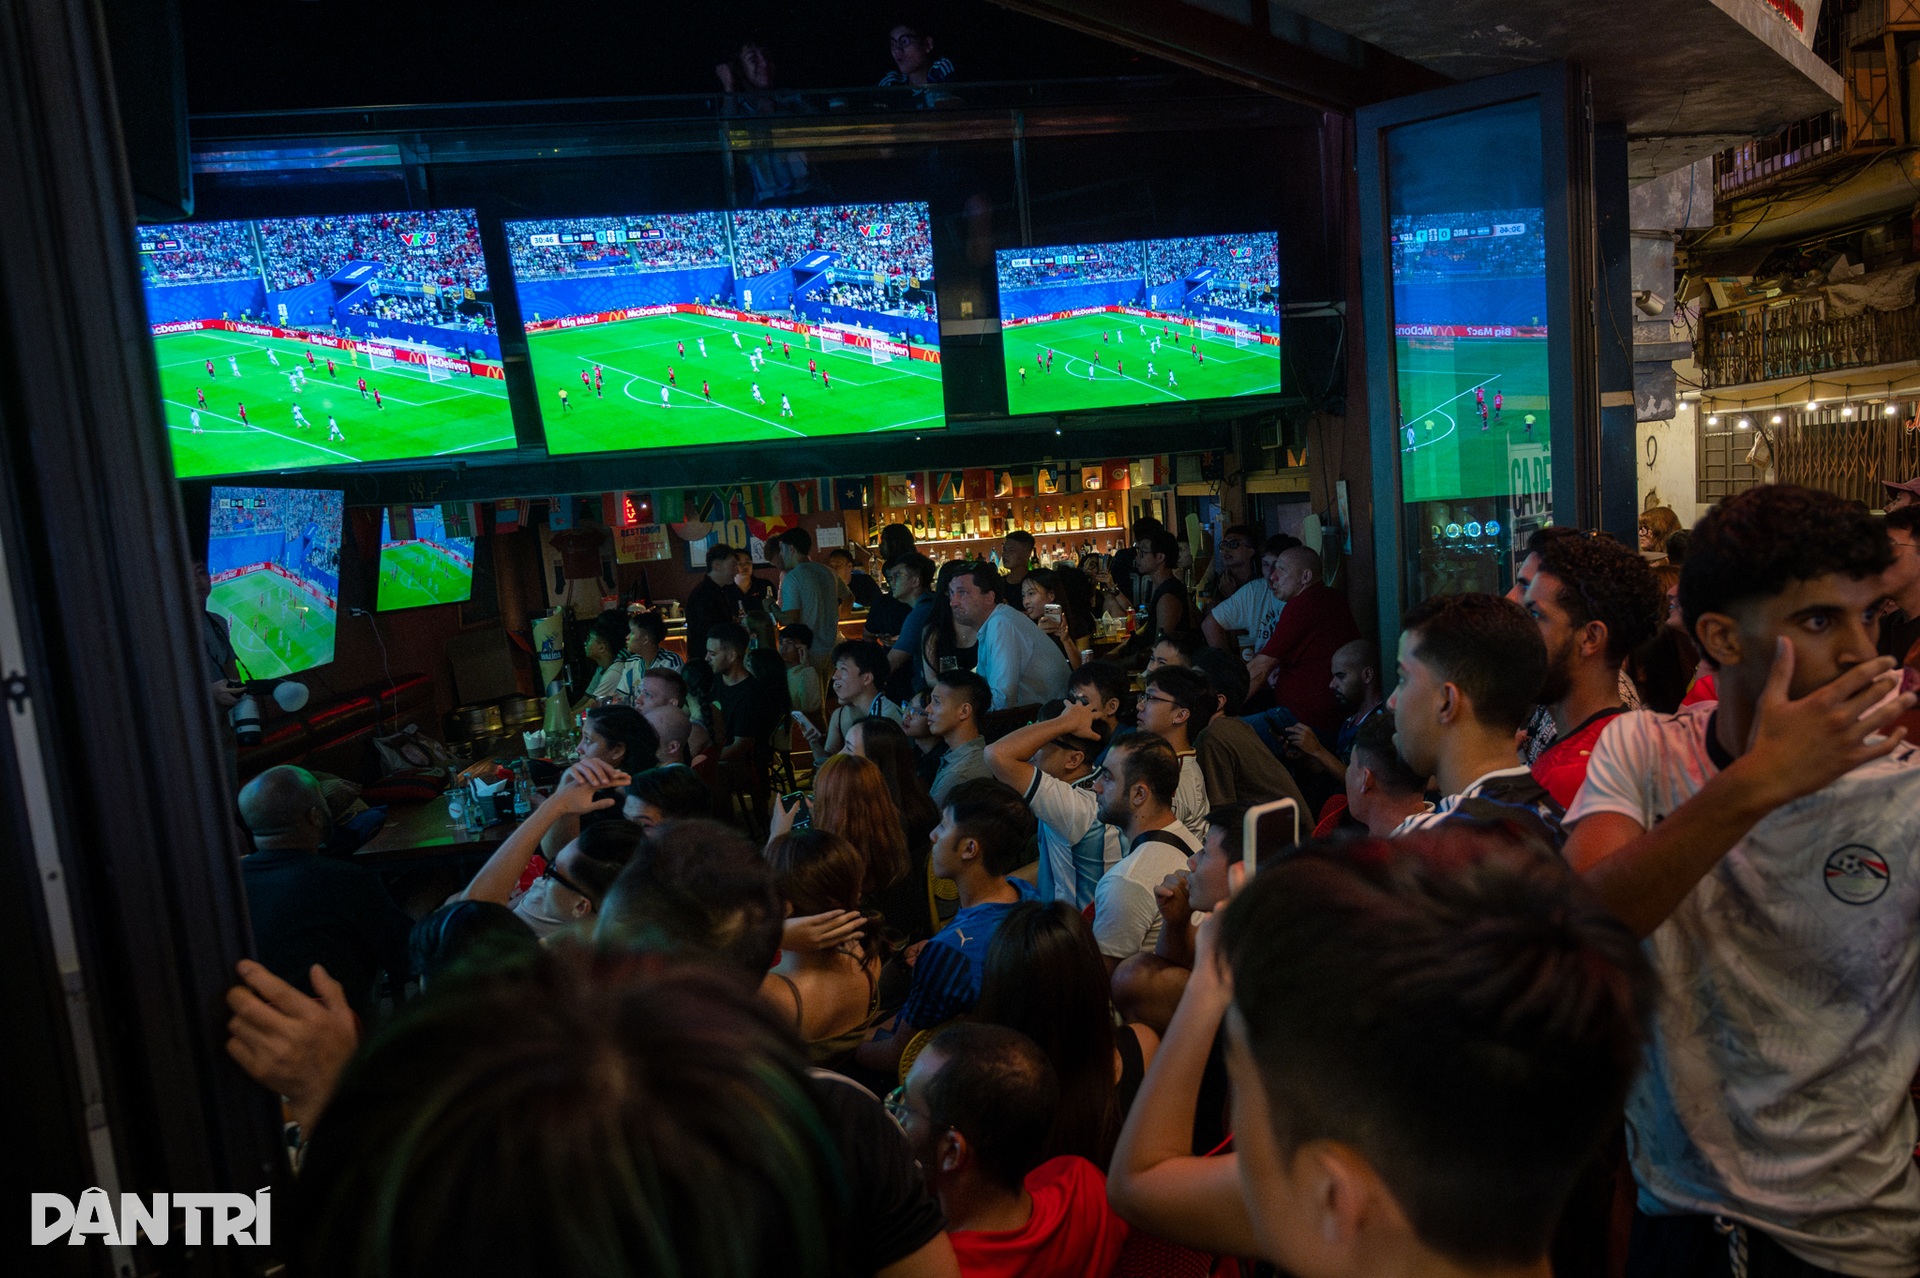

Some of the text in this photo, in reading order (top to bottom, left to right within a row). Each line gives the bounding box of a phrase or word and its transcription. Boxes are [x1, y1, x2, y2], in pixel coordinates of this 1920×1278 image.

[858, 224, 891, 237] VTV3
[400, 232, 437, 246] VTV3
[534, 236, 554, 244] 30:46
[627, 305, 677, 319] McDonald's
[367, 320, 379, 329] FIFA
[561, 315, 599, 328] Big Mac?
[237, 324, 273, 337] McDelivery
[312, 335, 338, 347] Big Mac?
[621, 525, 660, 537] RESTROOM
